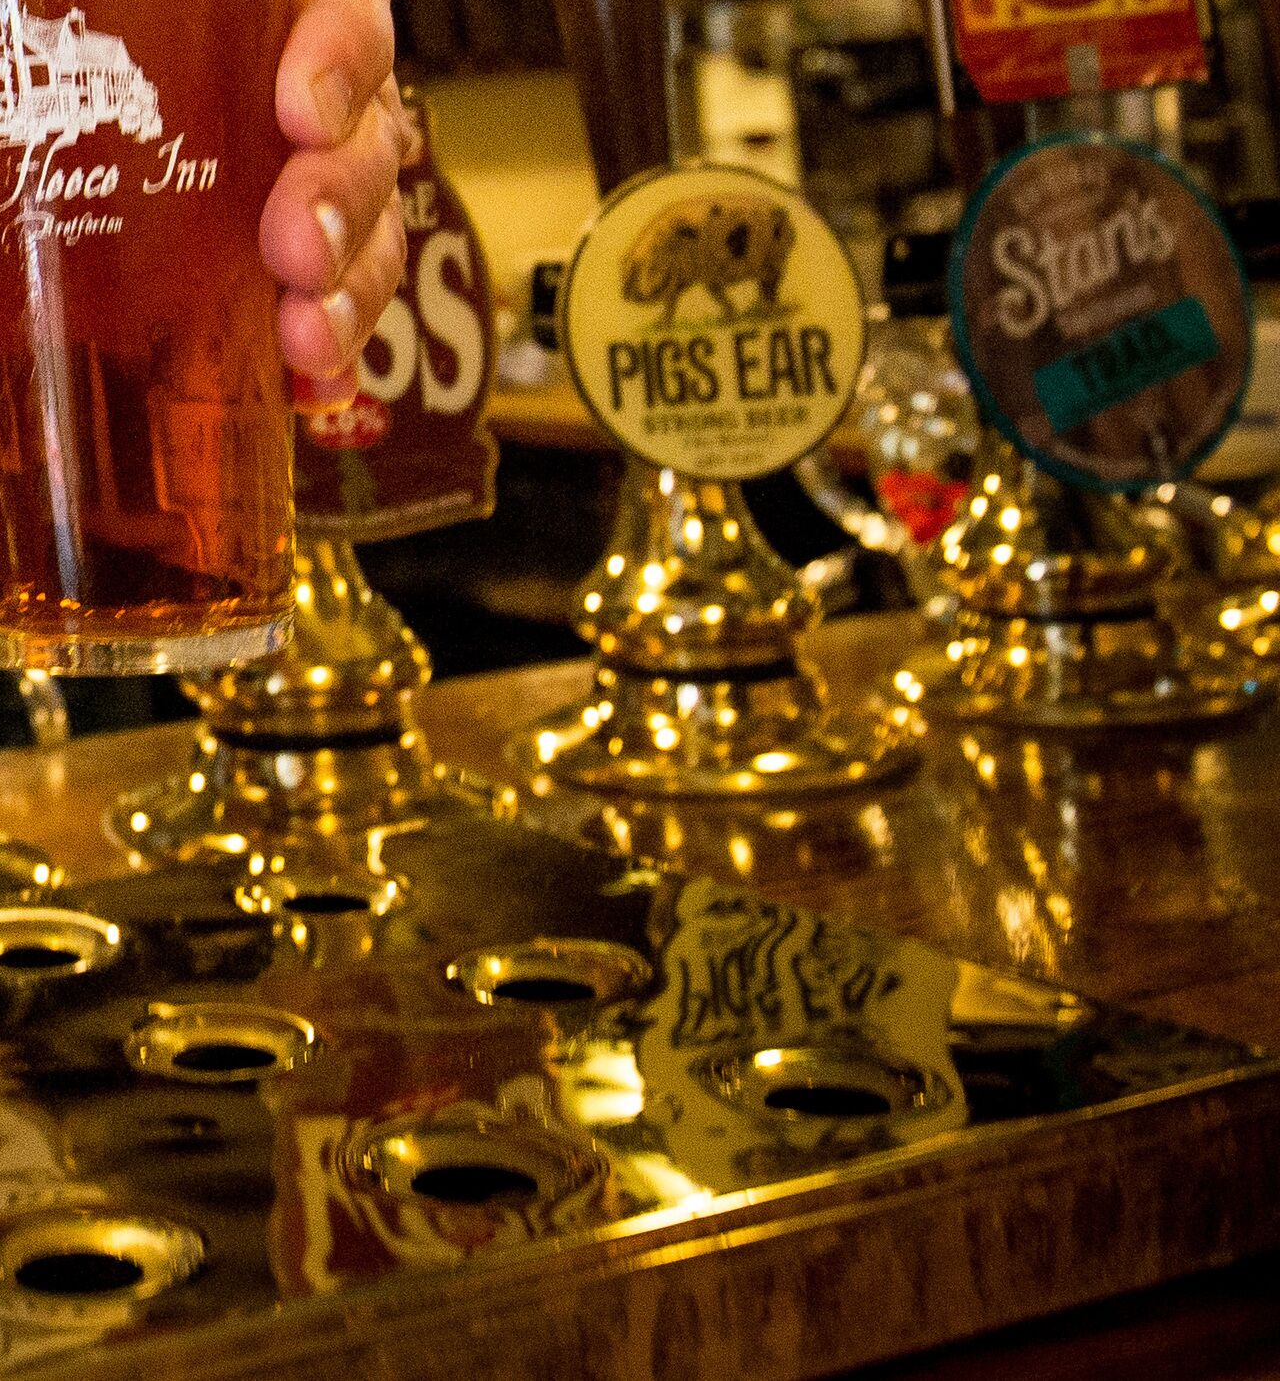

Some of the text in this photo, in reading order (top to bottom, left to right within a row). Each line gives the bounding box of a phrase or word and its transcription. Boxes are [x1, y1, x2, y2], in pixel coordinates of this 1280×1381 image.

[143, 133, 219, 195] Inn
[607, 324, 837, 411] PIGS EAR
